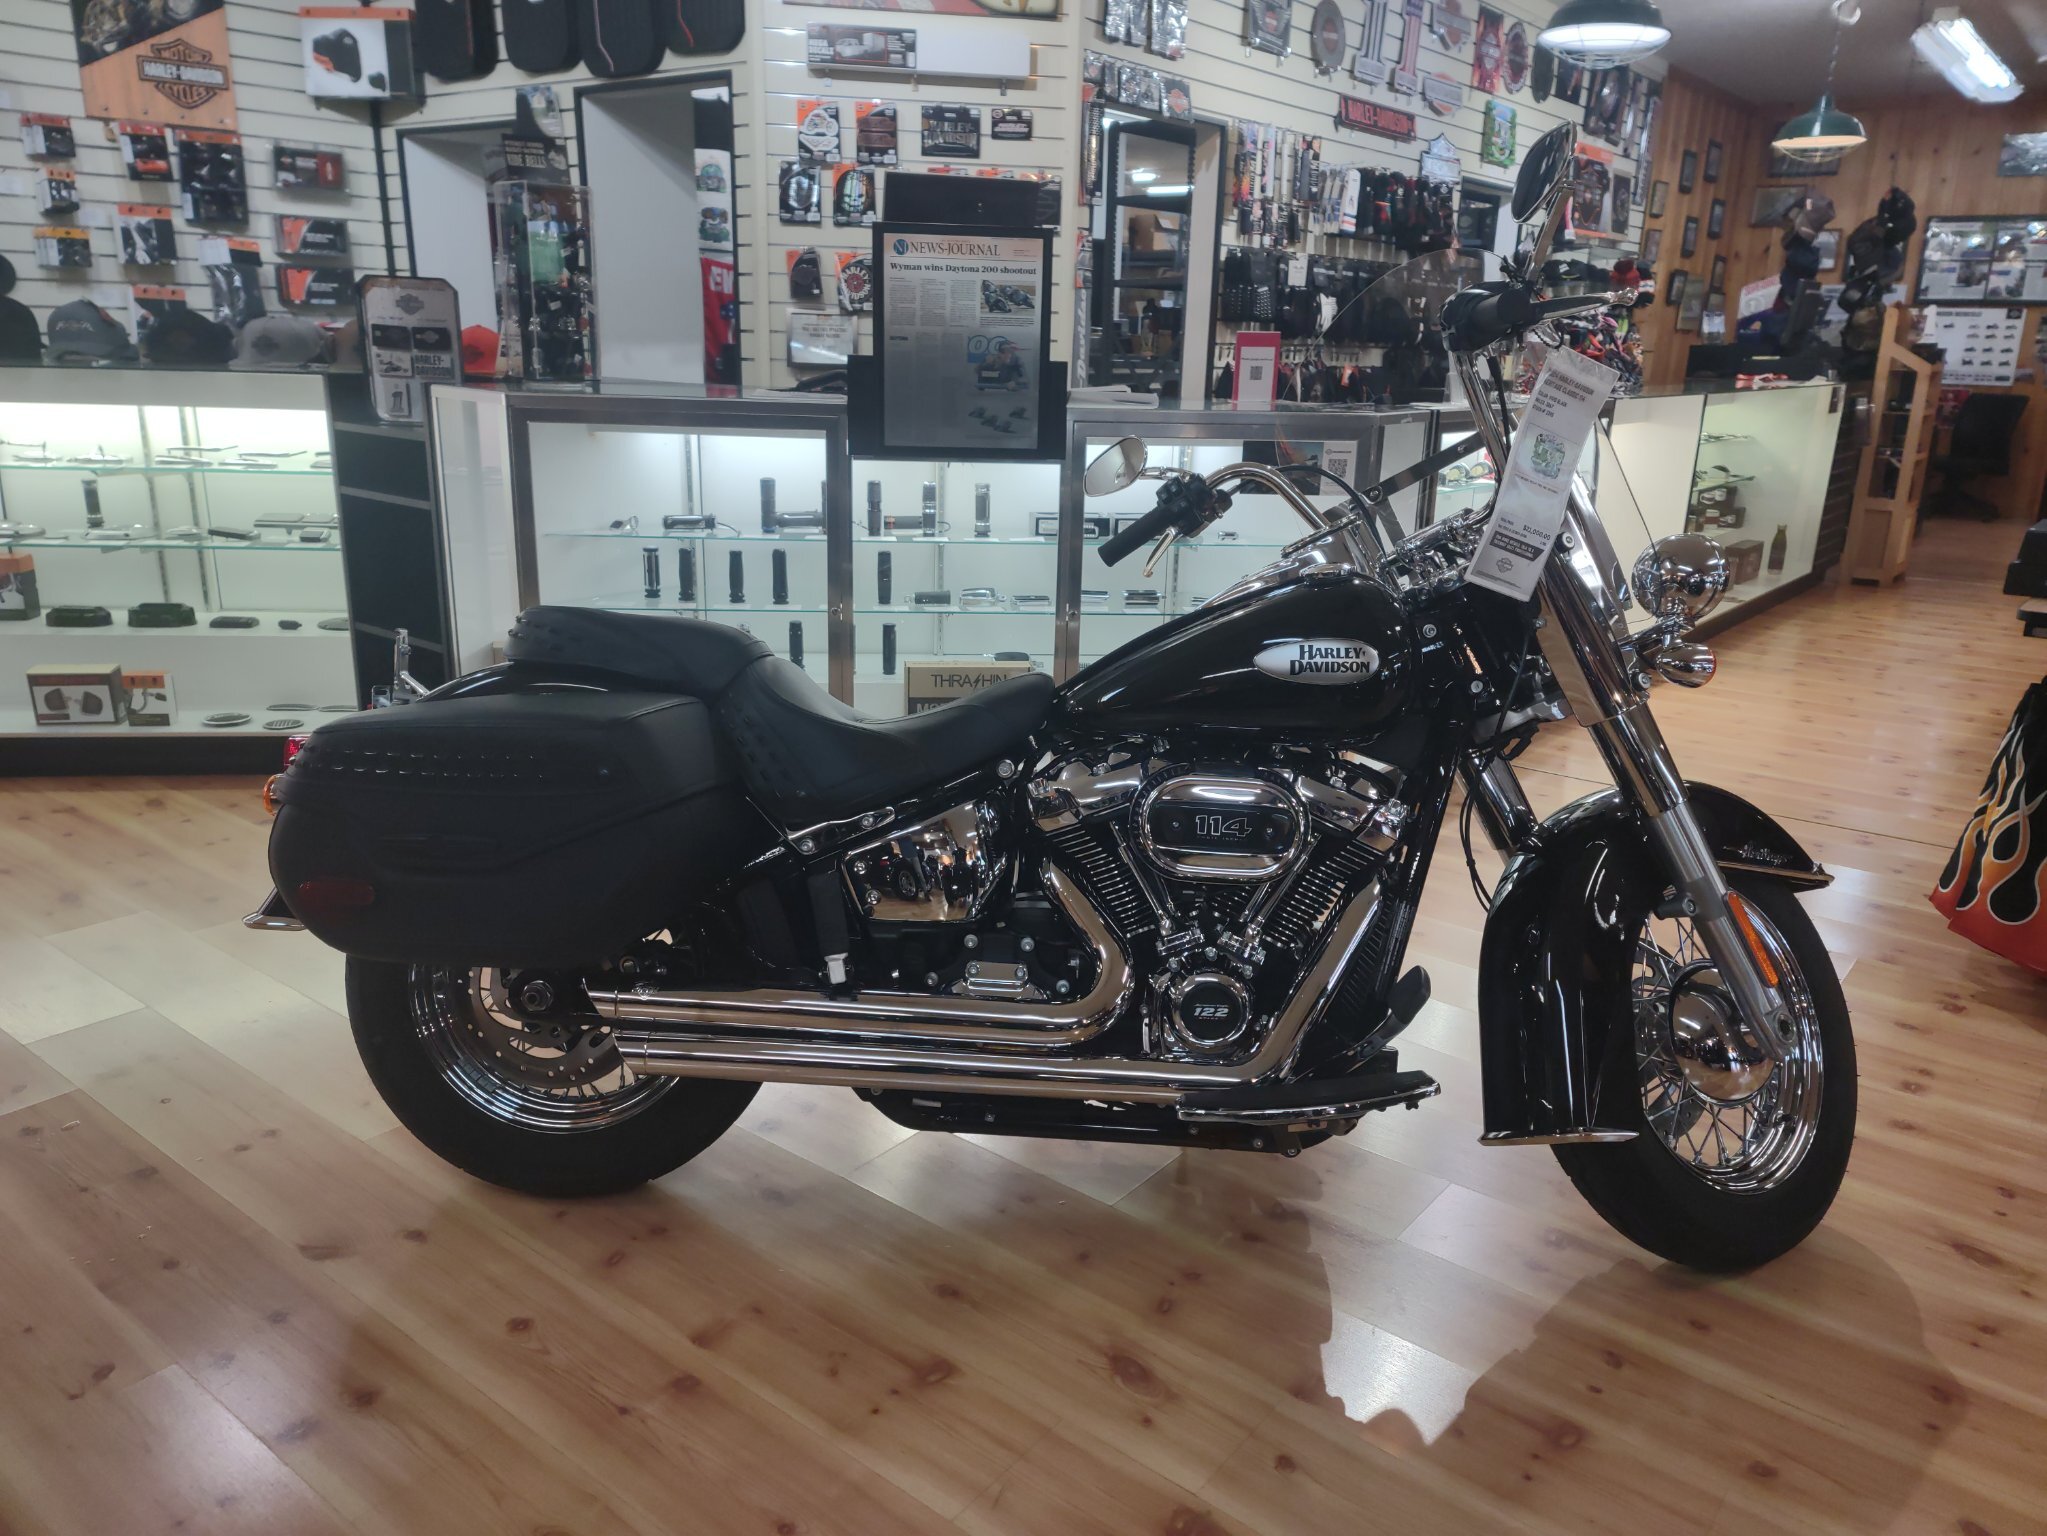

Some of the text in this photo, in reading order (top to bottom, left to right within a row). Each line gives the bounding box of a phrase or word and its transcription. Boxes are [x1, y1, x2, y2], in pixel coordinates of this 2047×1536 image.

[910, 241, 1000, 256] NEWS-JOURNAL
[890, 262, 1036, 275] Wyman wins Daytona 200 shootout
[1289, 659, 1371, 676] DAVIDSON
[1195, 814, 1253, 837] 114
[1193, 1007, 1229, 1017] 122
